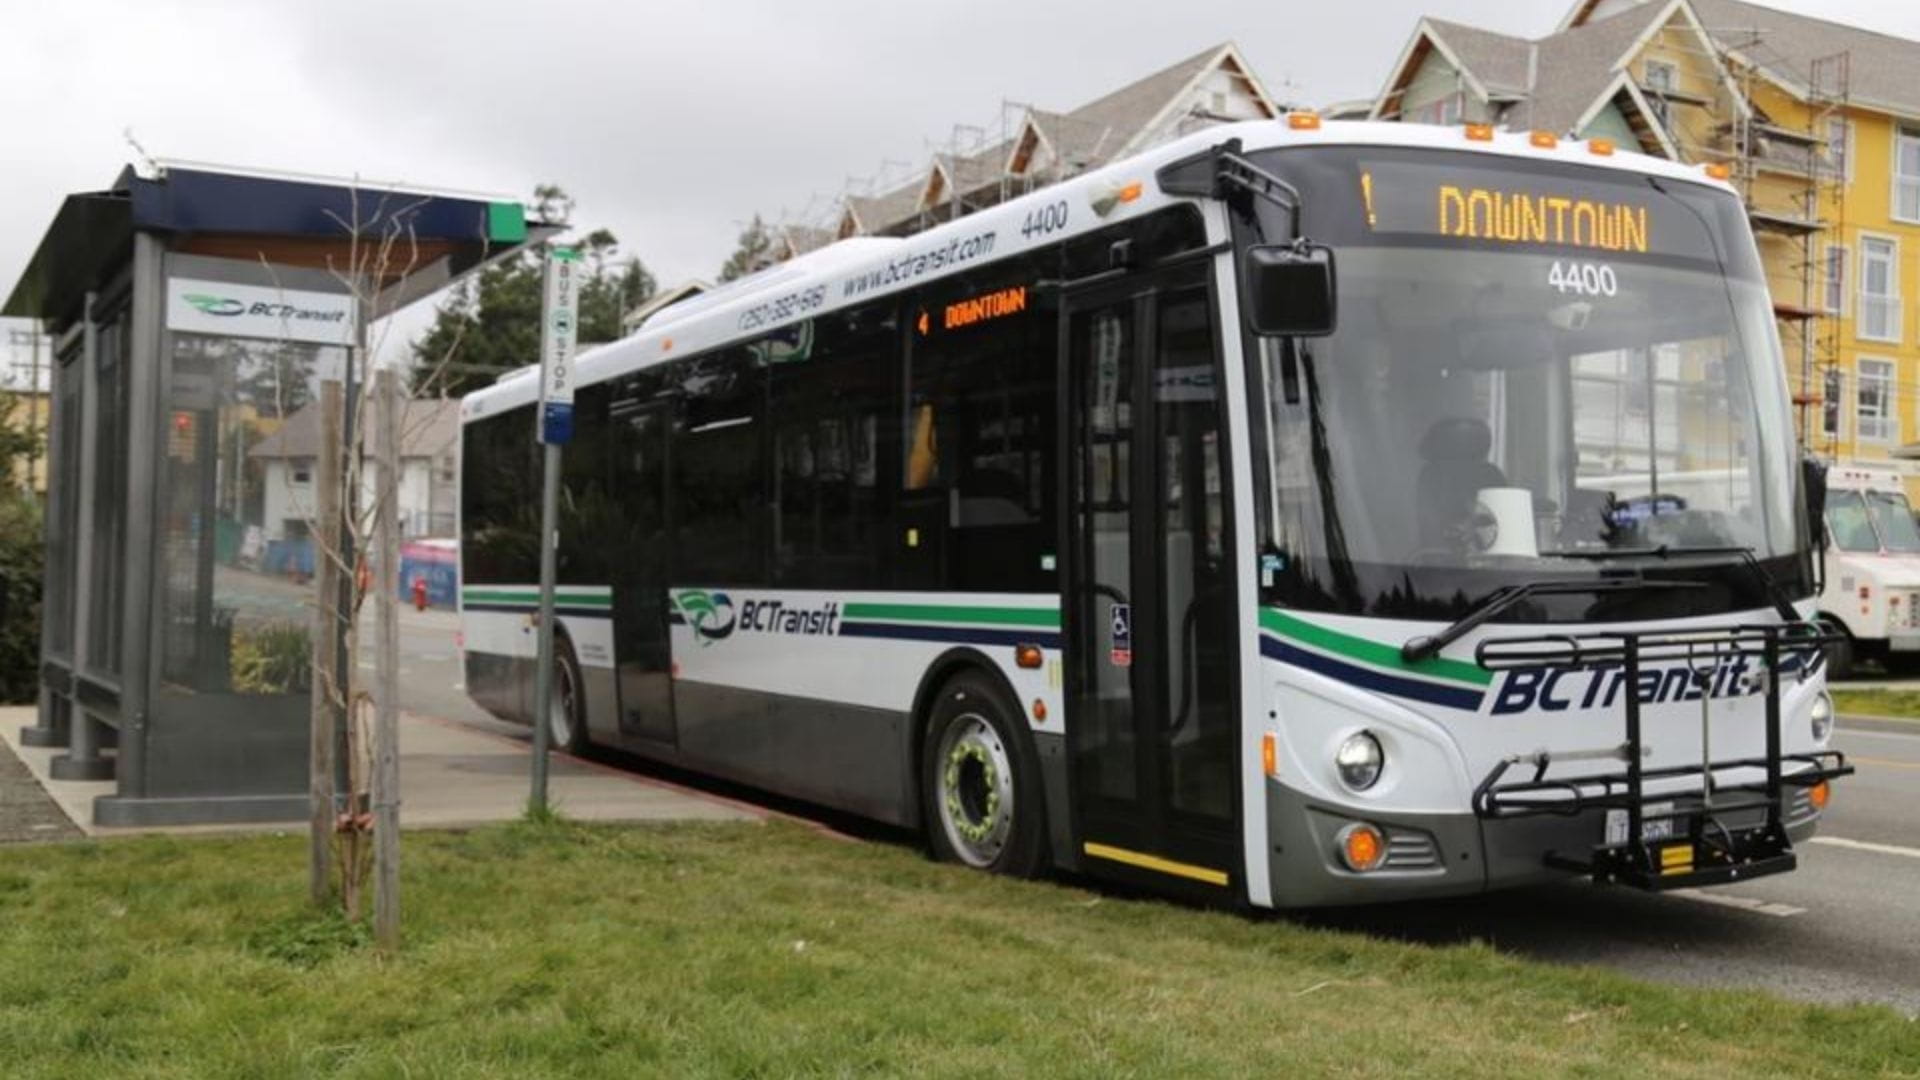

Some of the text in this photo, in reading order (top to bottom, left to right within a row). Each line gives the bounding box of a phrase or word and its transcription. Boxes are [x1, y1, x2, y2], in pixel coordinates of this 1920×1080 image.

[1021, 200, 1068, 240] 4400
[1439, 185, 1648, 253] DOWNTOWN
[844, 231, 996, 297] www.bctransit.com
[1548, 260, 1617, 297] 4400
[554, 264, 570, 391] BUS STOP
[945, 286, 1025, 330] DOWNTOWN
